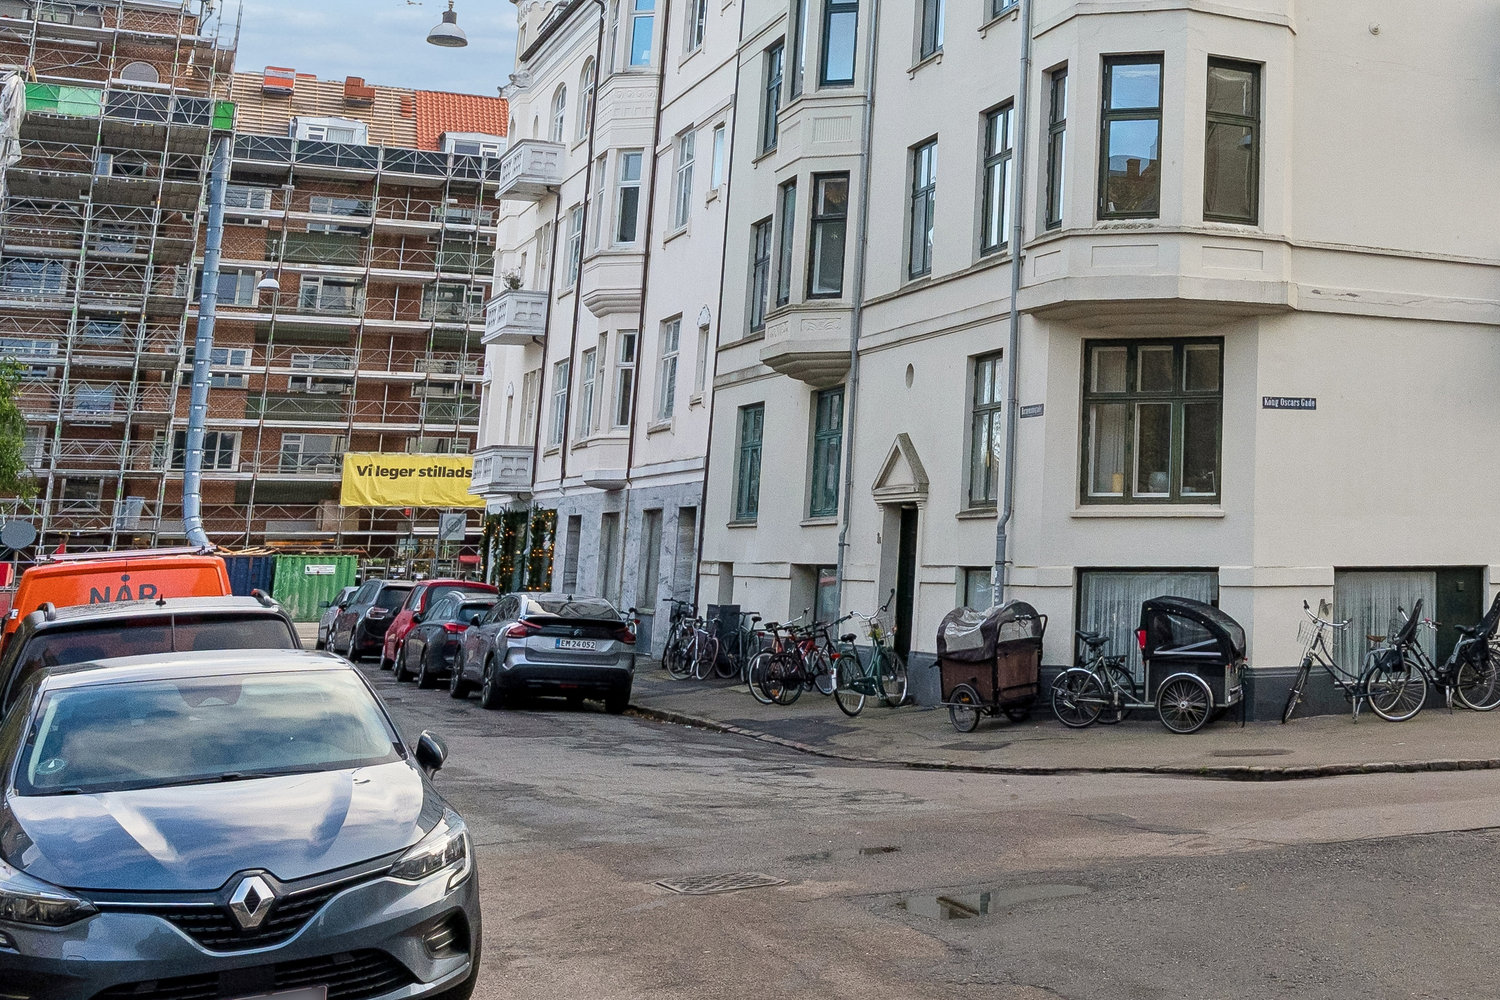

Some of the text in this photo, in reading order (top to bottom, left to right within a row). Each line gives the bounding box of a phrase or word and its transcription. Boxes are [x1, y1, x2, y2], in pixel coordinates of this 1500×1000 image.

[1280, 398, 1300, 406] Oscars
[357, 464, 473, 480] Vi leger stillads
